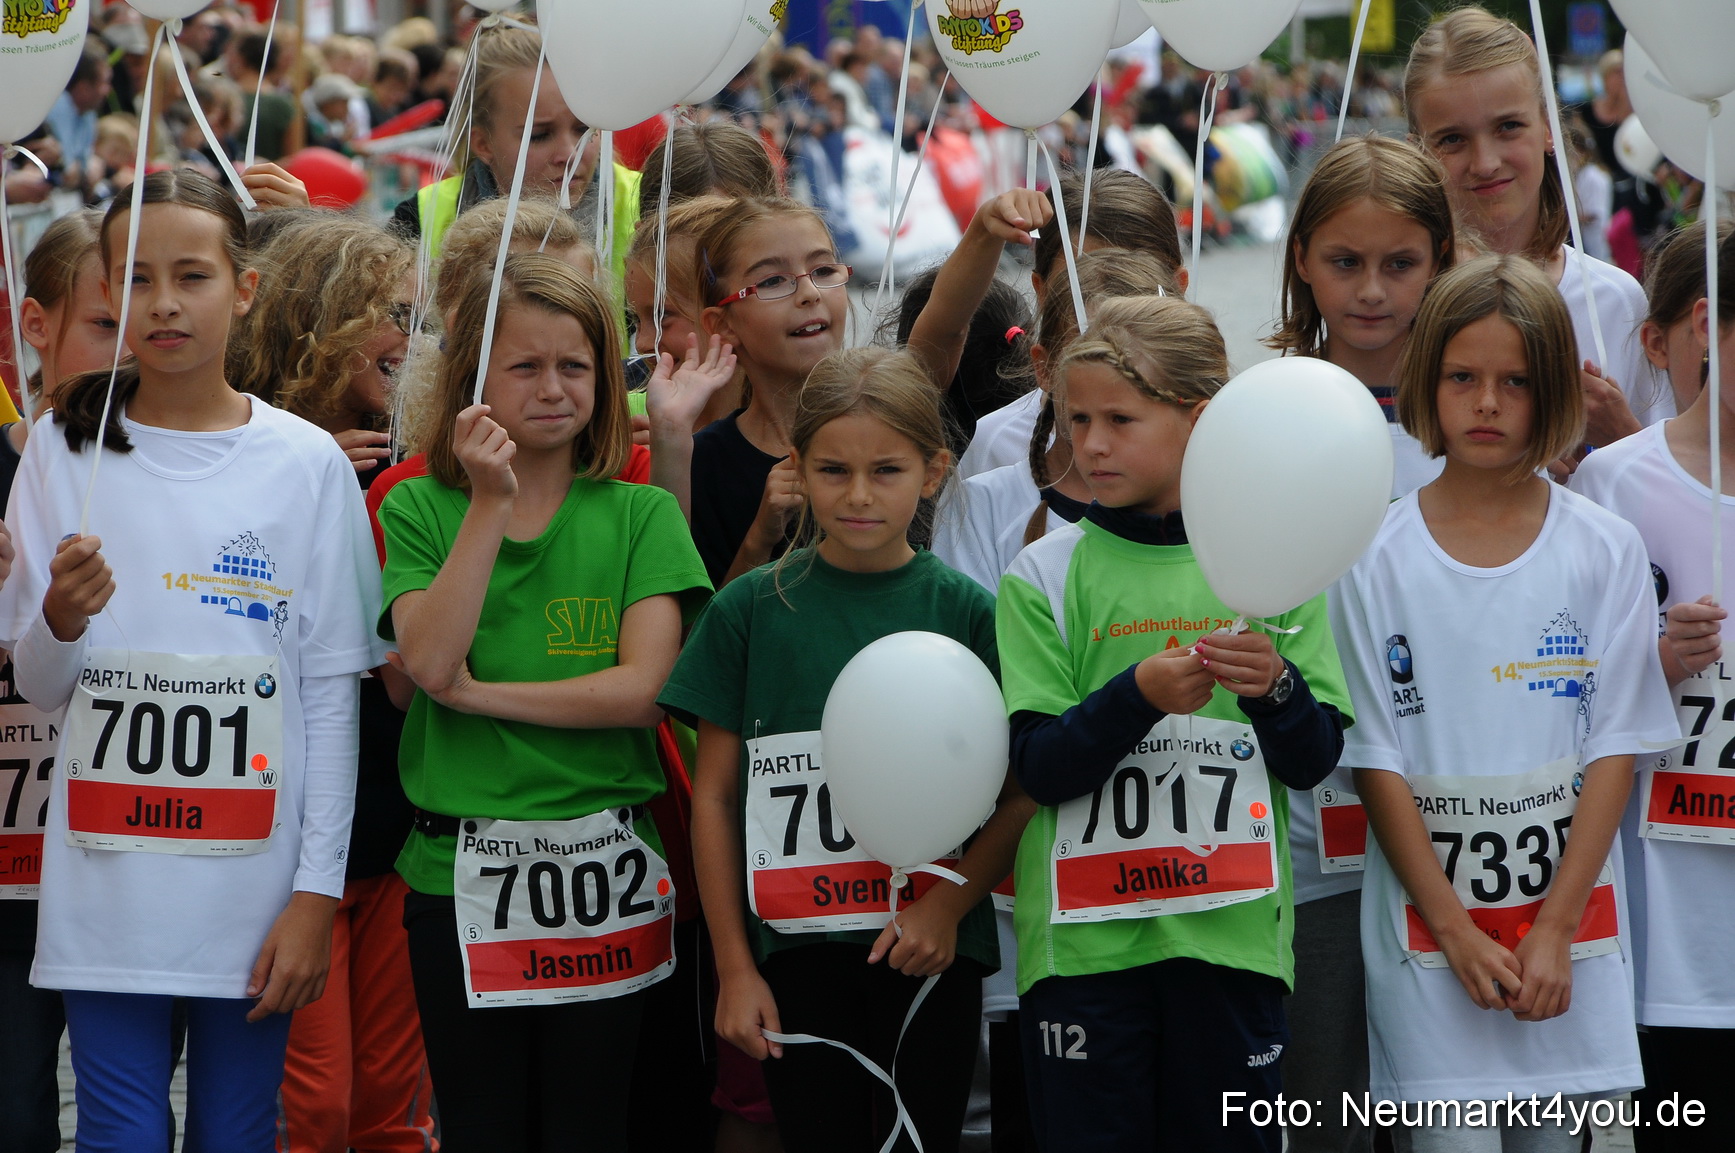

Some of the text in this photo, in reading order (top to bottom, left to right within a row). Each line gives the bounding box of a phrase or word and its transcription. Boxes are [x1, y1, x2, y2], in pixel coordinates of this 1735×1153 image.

[2, 13, 60, 38] stiftung
[937, 9, 1024, 37] PHYTOKIDS
[25, 44, 57, 54] Träume
[952, 36, 1003, 55] stiftung
[975, 60, 1006, 69] Träume
[1007, 50, 1041, 64] steigen
[161, 572, 196, 591] 14.
[191, 573, 251, 588] Neumarkter
[545, 597, 618, 646] SVA
[1092, 628, 1105, 642] 1.
[1109, 617, 1210, 638] Goldhutlauf
[81, 668, 246, 695] PARTL Neumarkt
[1491, 662, 1523, 682] 14.
[91, 699, 248, 777] 7001
[1129, 737, 1223, 756] eumarkt
[752, 753, 820, 777] PARTL
[262, 772, 274, 785] W
[1324, 790, 1332, 803] 5
[1413, 784, 1566, 816] PARTL Neumarkt
[125, 796, 203, 830] Julia
[463, 827, 633, 858] PARTL Neumarkt
[1253, 825, 1265, 838] W
[1113, 857, 1209, 895] Janika
[479, 848, 655, 930] 7002
[813, 875, 915, 907] Svena
[522, 945, 633, 981] Jasmin
[1039, 1020, 1088, 1060] 112
[1247, 1051, 1277, 1067] JAKO
